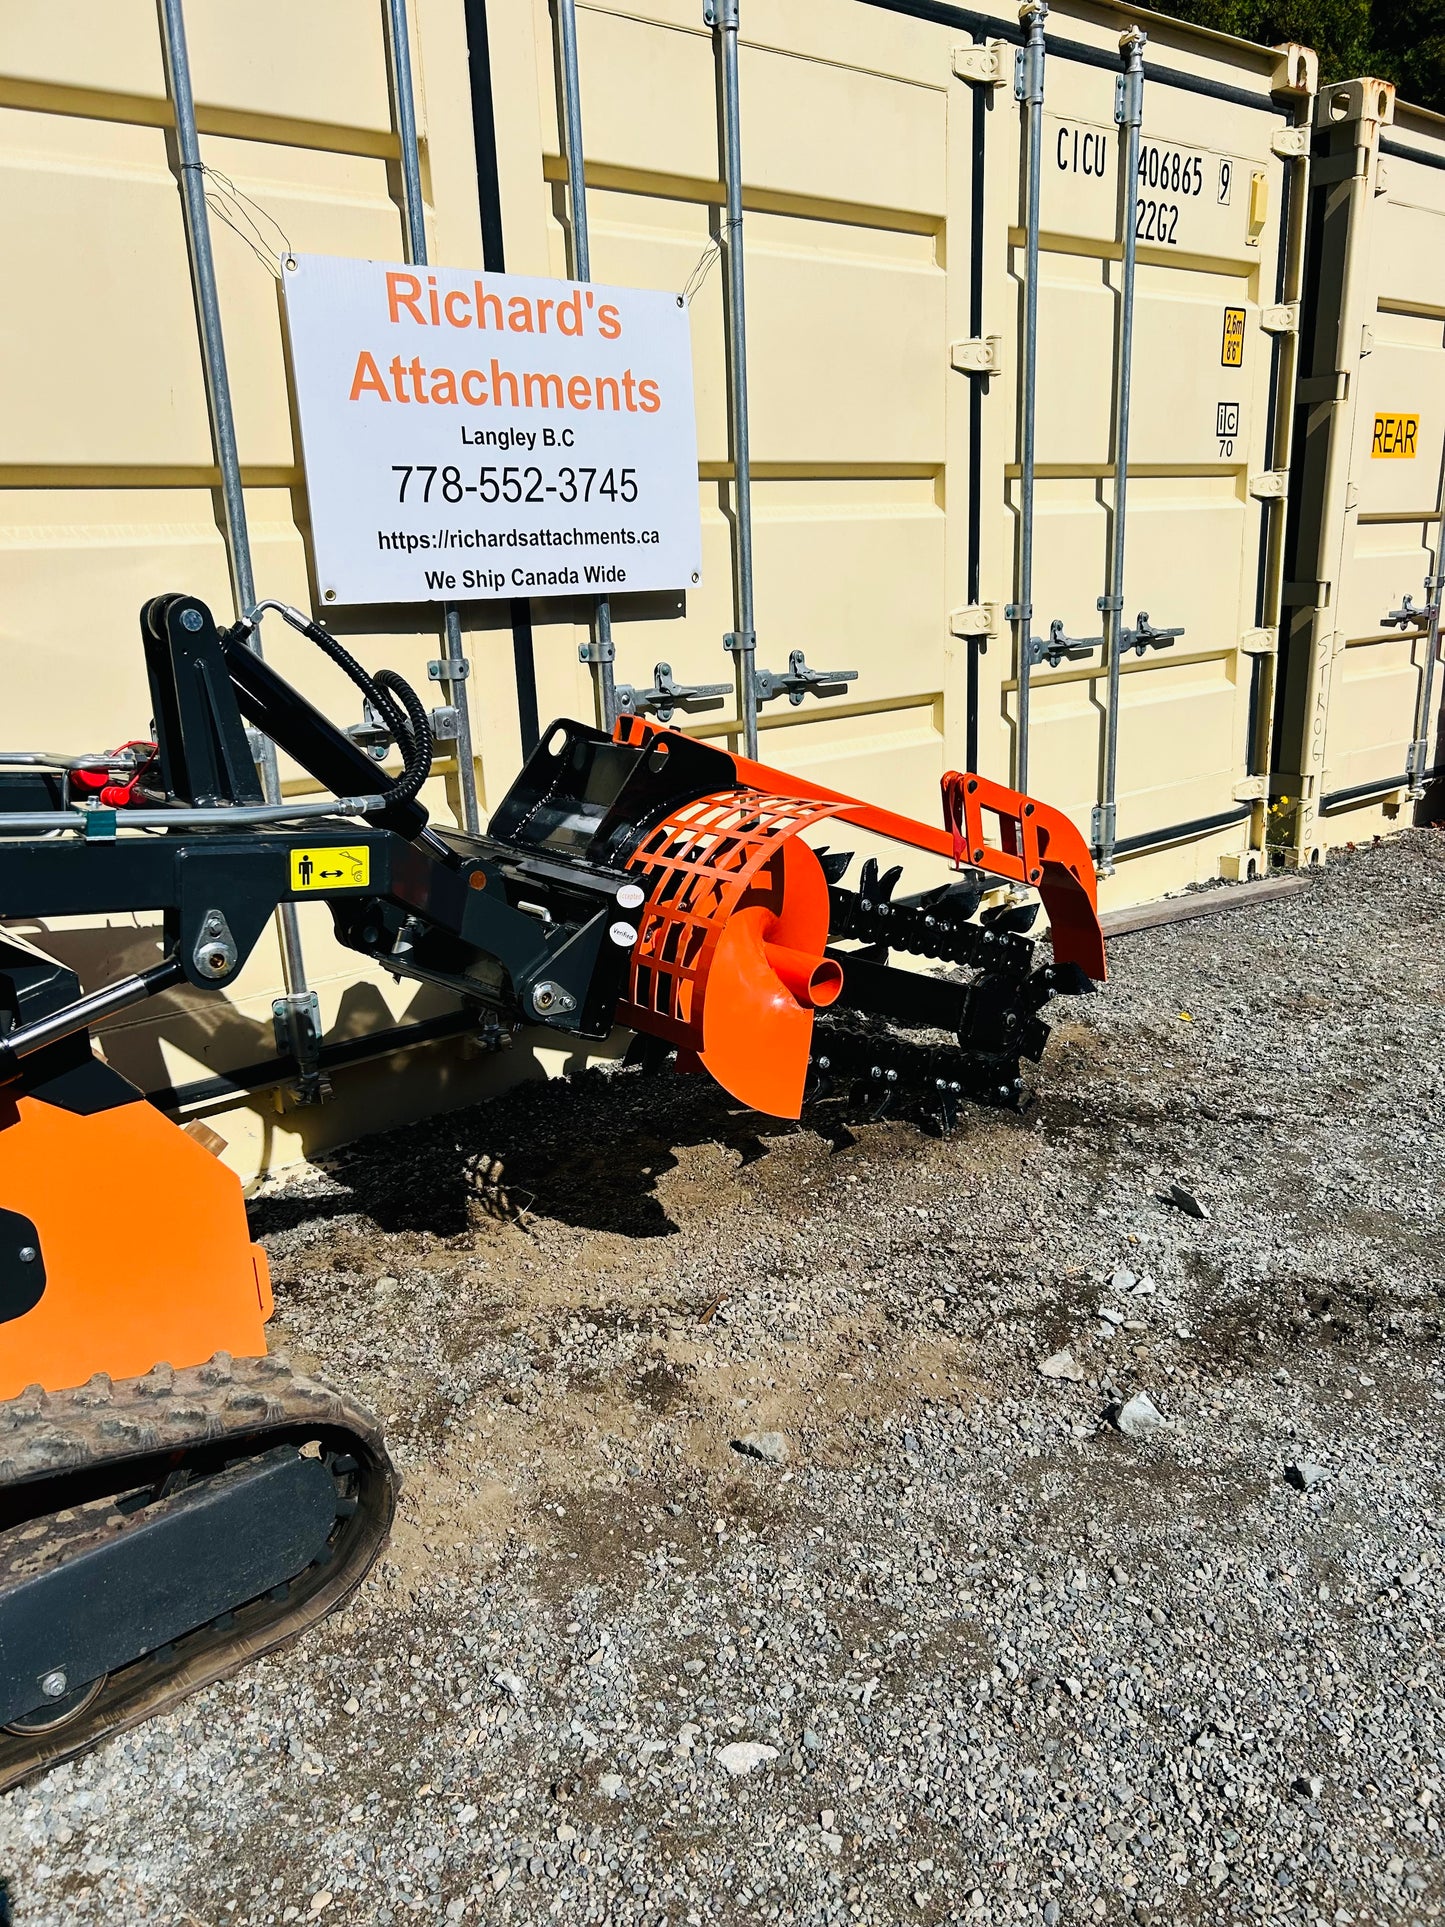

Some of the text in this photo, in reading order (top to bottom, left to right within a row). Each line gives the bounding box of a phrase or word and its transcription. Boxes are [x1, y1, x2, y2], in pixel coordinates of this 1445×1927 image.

[1057, 127, 1230, 201] CICU 406865 9
[1136, 198, 1179, 245] 22G2
[385, 272, 622, 340] Richard's
[349, 350, 661, 413] Attachments
[461, 425, 575, 451] Langley B.C
[1219, 440, 1234, 458] 70
[1371, 418, 1417, 454] REAR
[391, 465, 639, 504] 778-552-3745
[377, 527, 660, 554] https://richardsattachments.ca
[424, 565, 627, 592] We Ship Canada Wide
